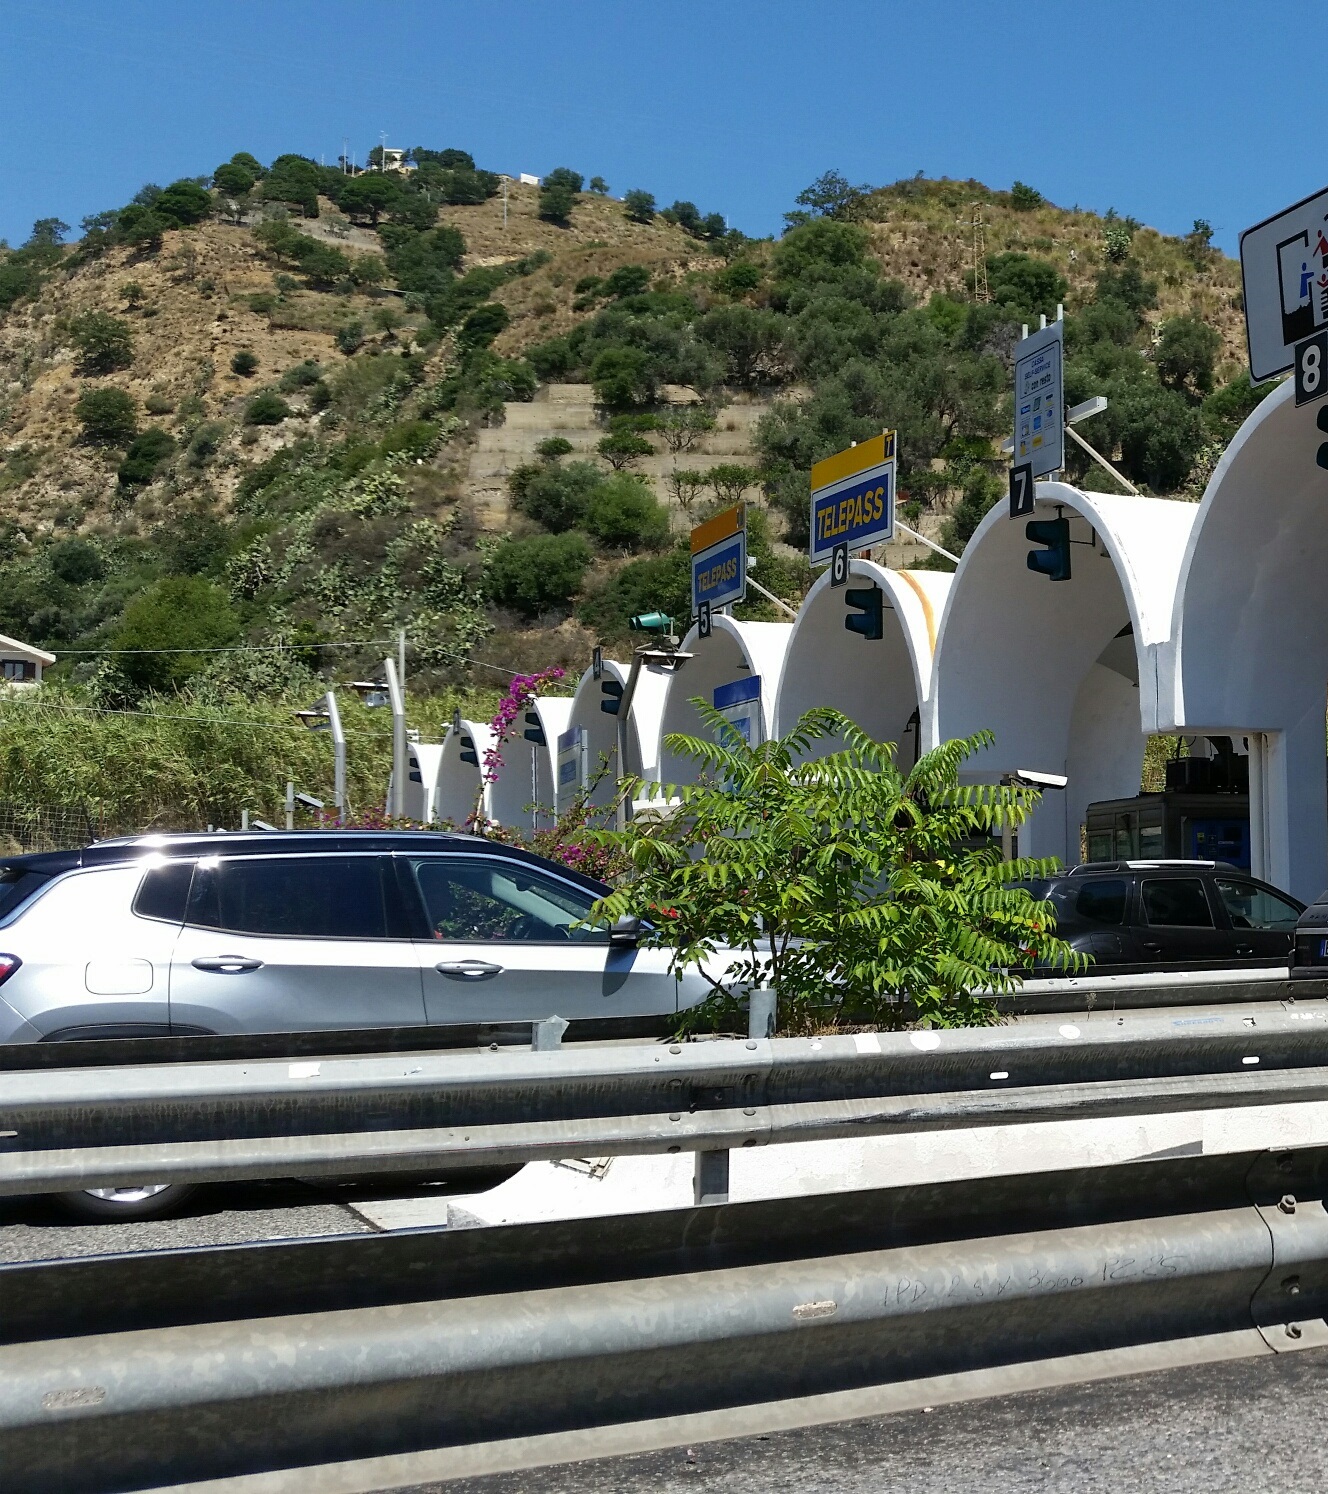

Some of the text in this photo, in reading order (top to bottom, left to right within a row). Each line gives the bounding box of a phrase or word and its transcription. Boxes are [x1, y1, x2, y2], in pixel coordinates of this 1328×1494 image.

[1301, 344, 1321, 393] 8
[886, 435, 893, 457] T
[1014, 470, 1027, 510] 7
[817, 486, 885, 541] TELEPASS
[697, 557, 737, 593] TELEPASS
[834, 548, 845, 581] 6
[700, 606, 708, 634] 5
